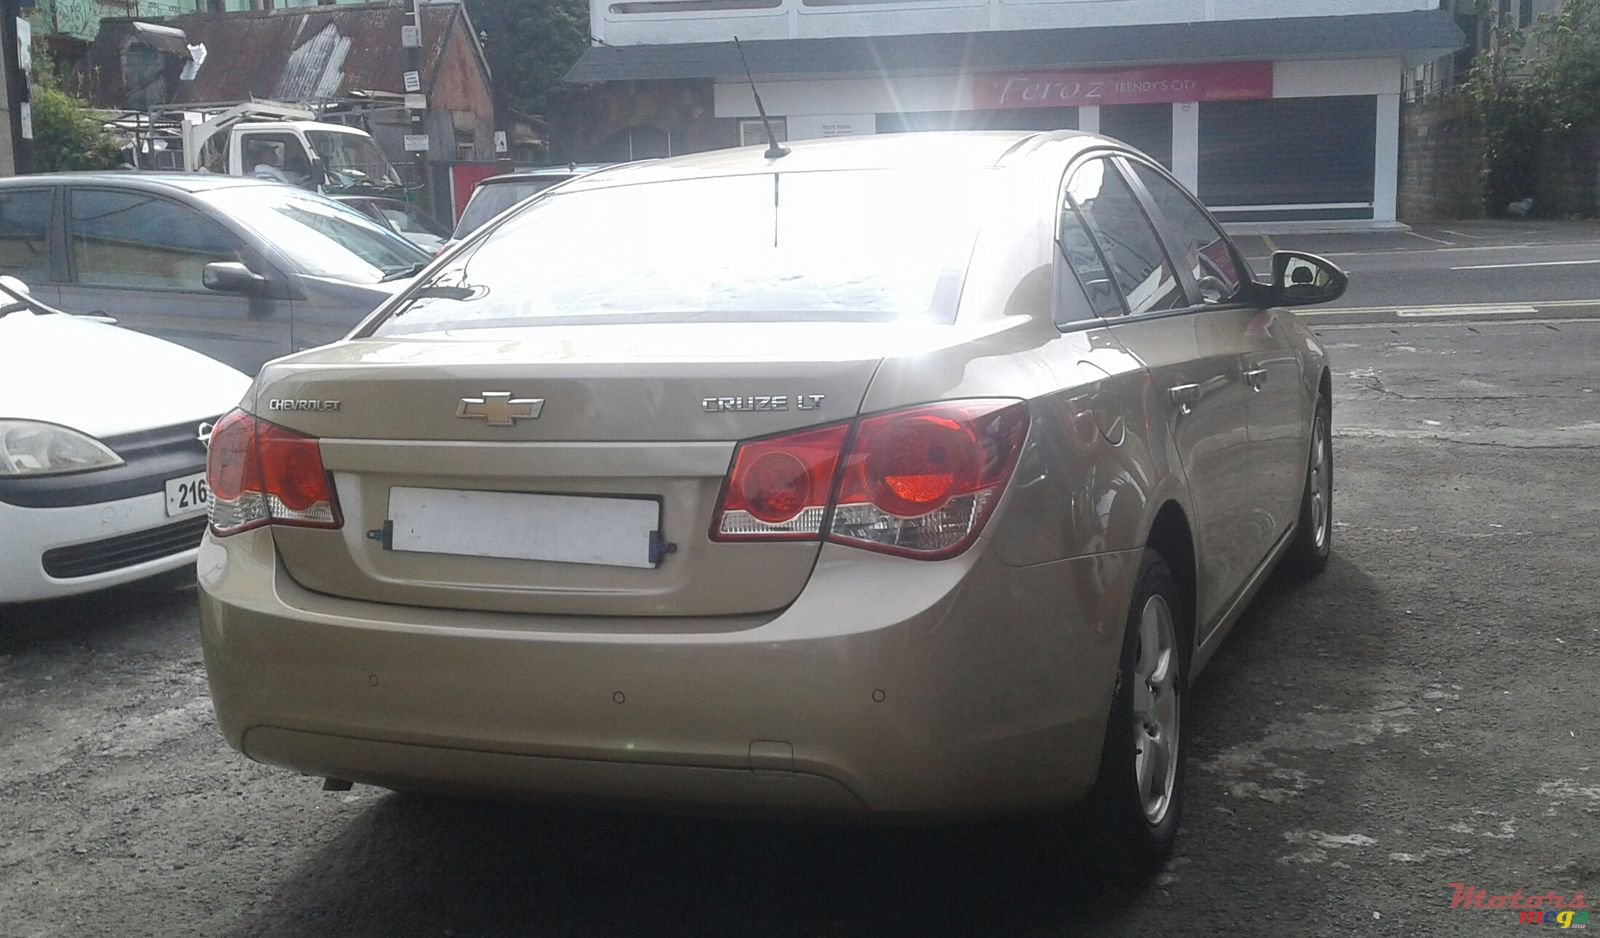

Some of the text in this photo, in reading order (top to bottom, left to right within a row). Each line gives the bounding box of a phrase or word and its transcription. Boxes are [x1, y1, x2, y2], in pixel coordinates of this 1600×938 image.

[1171, 79, 1197, 91] CITY
[269, 398, 341, 411] CHEVROLET
[702, 394, 825, 412] CRUZE LT
[178, 479, 208, 509] 216
